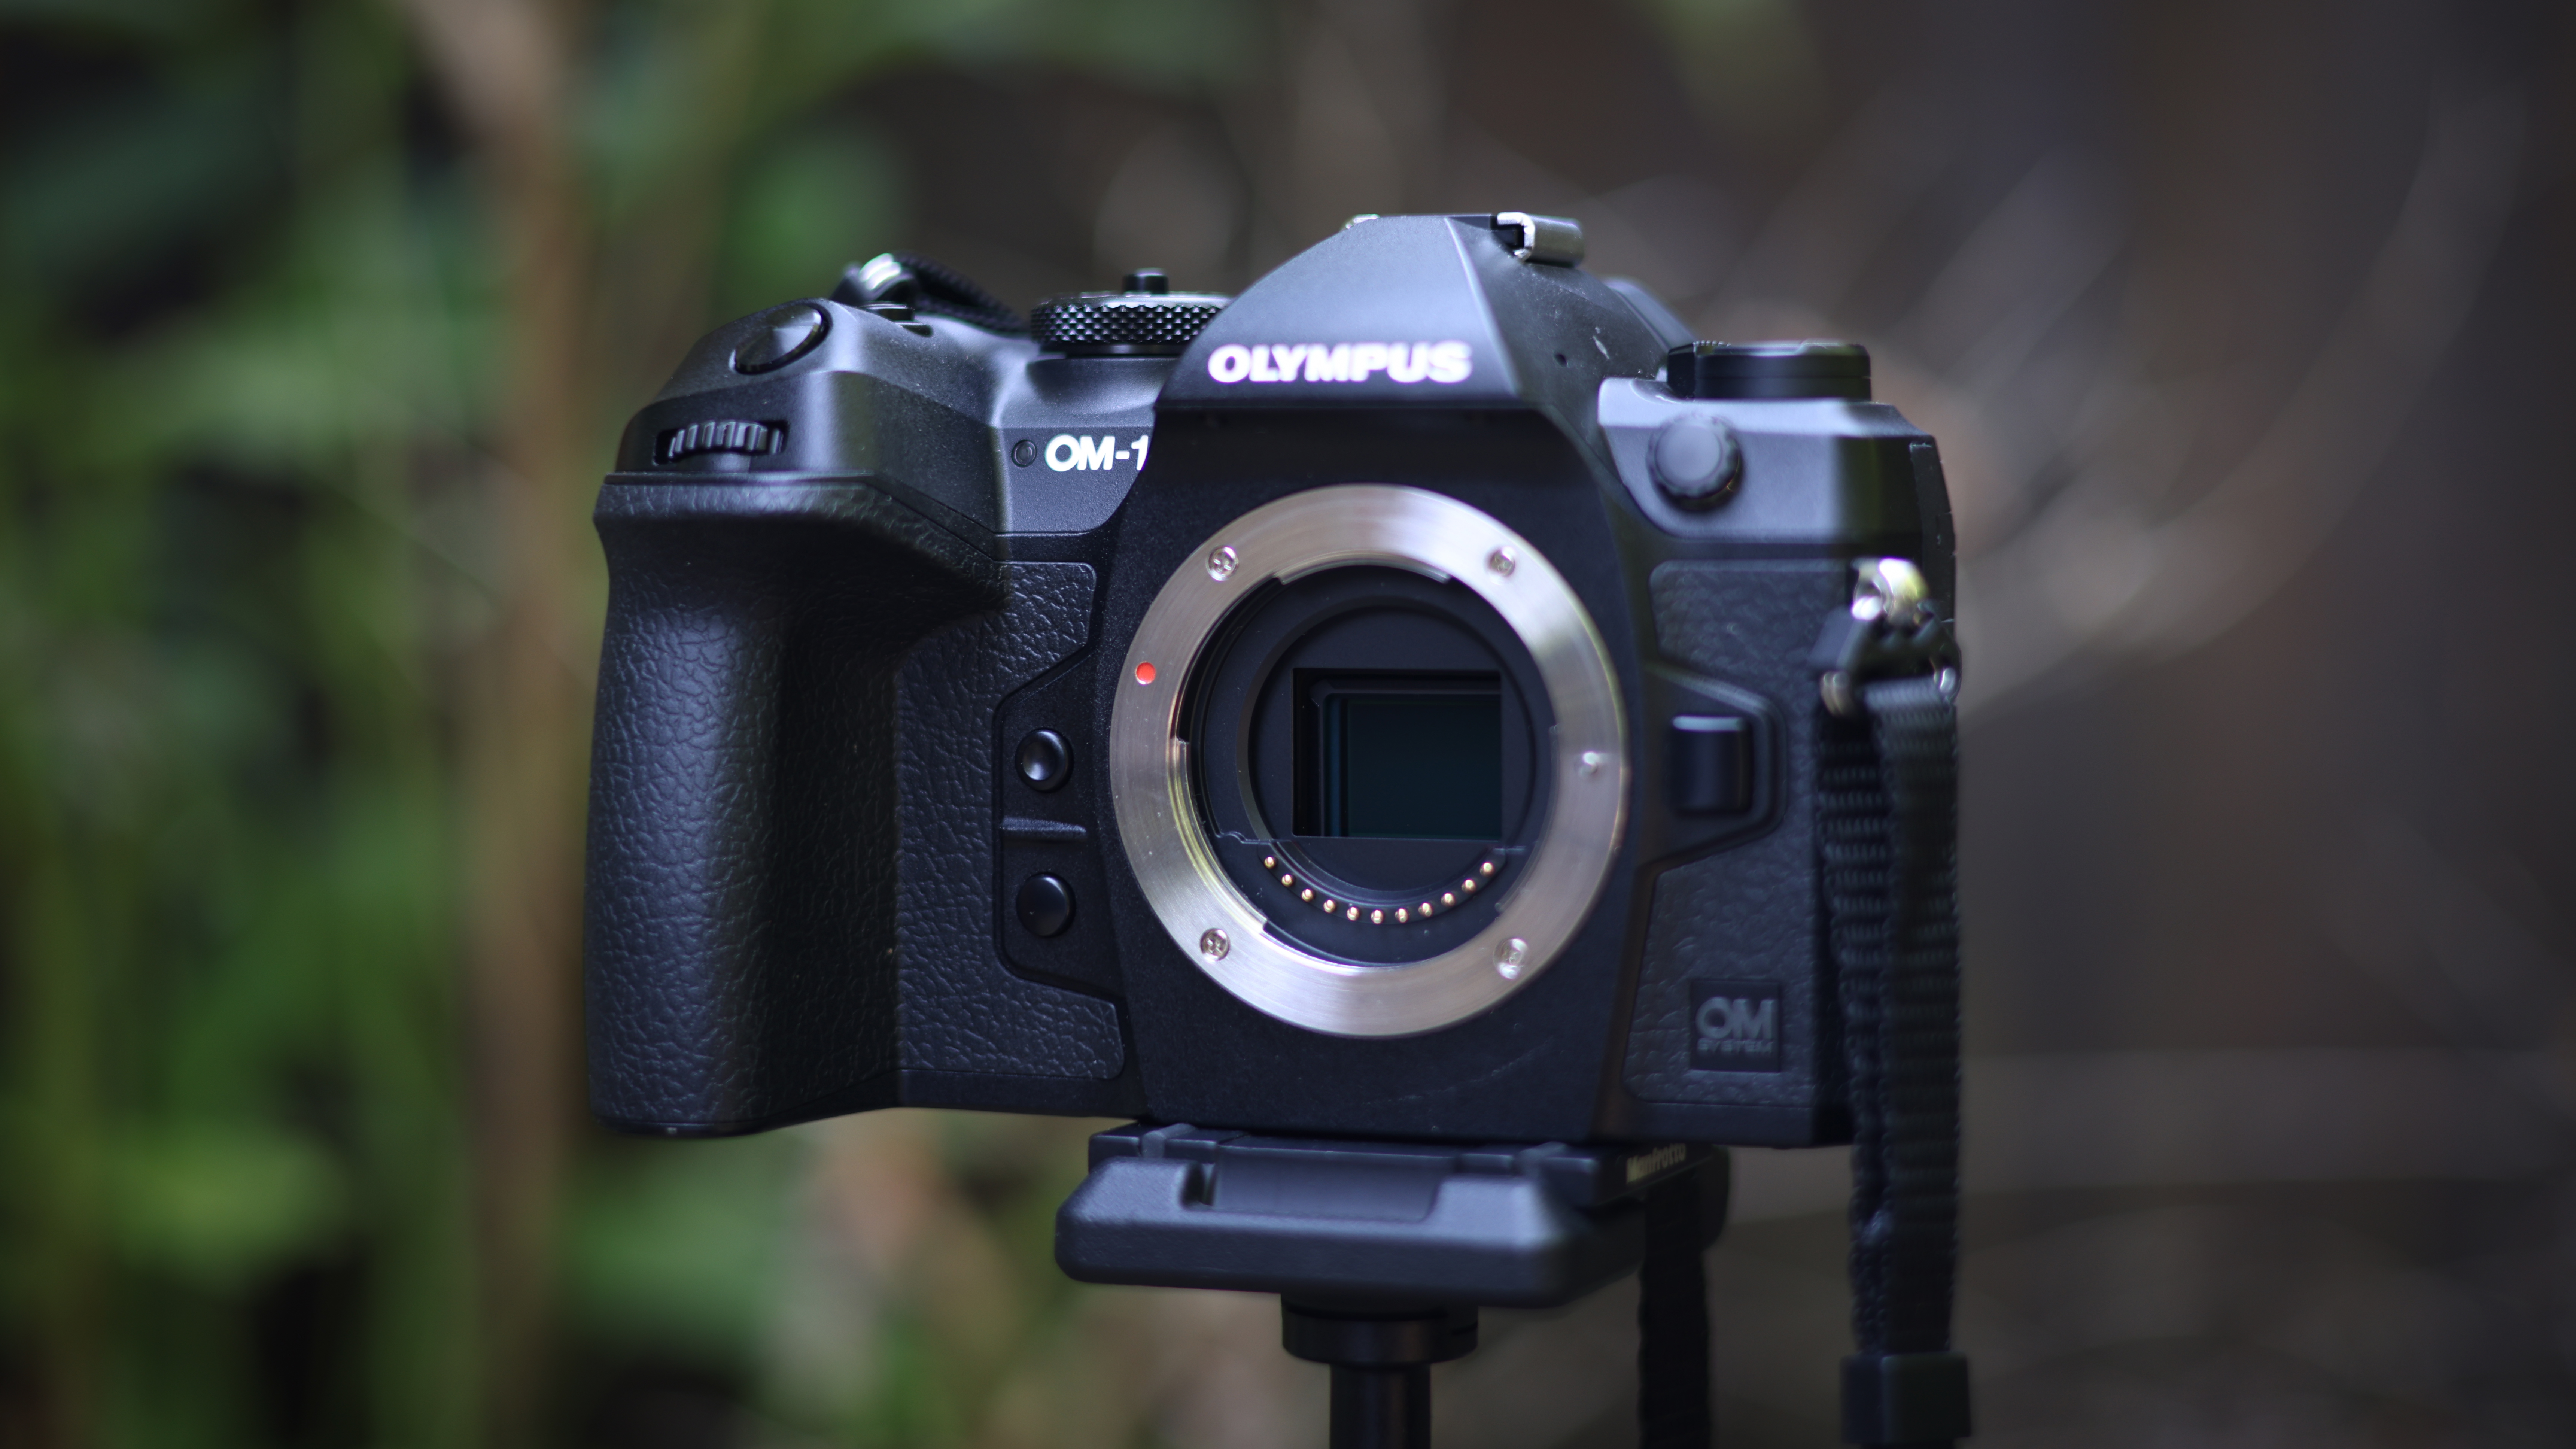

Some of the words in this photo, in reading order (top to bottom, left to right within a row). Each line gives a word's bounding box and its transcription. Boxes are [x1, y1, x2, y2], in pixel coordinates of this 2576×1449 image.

[1208, 341, 1472, 383] OLYMPUS
[1044, 433, 1149, 472] OM-1
[1695, 996, 1777, 1039] OM
[1697, 1038, 1774, 1054] SYSTEM
[1626, 1143, 1686, 1184] Manfrotto
